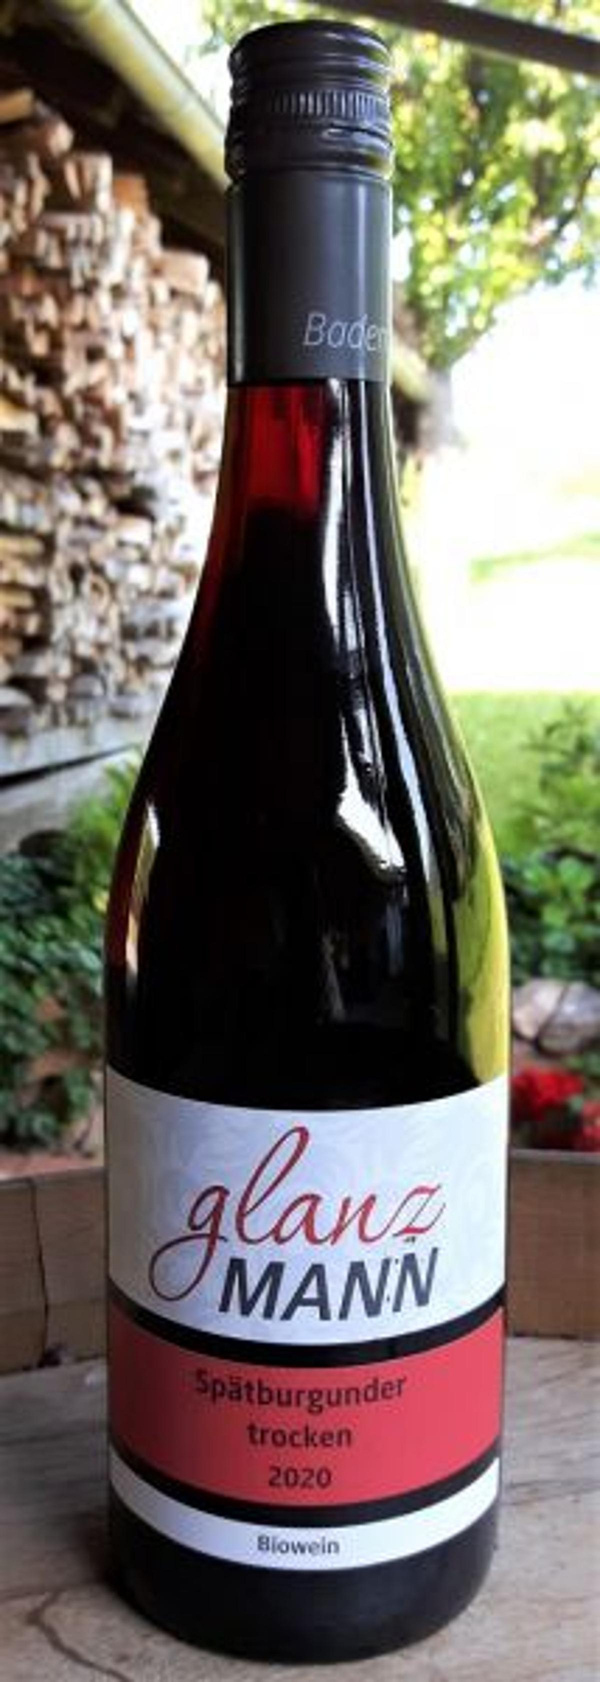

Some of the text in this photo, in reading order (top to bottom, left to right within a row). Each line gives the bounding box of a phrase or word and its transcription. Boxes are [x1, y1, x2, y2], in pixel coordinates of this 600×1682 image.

[148, 1126, 446, 1301] glanz
[218, 1246, 439, 1321] MANN
[194, 1369, 407, 1414] Spätburgunder
[246, 1423, 353, 1449] trocken
[267, 1466, 333, 1490] 2020
[256, 1534, 341, 1556] Biowein
